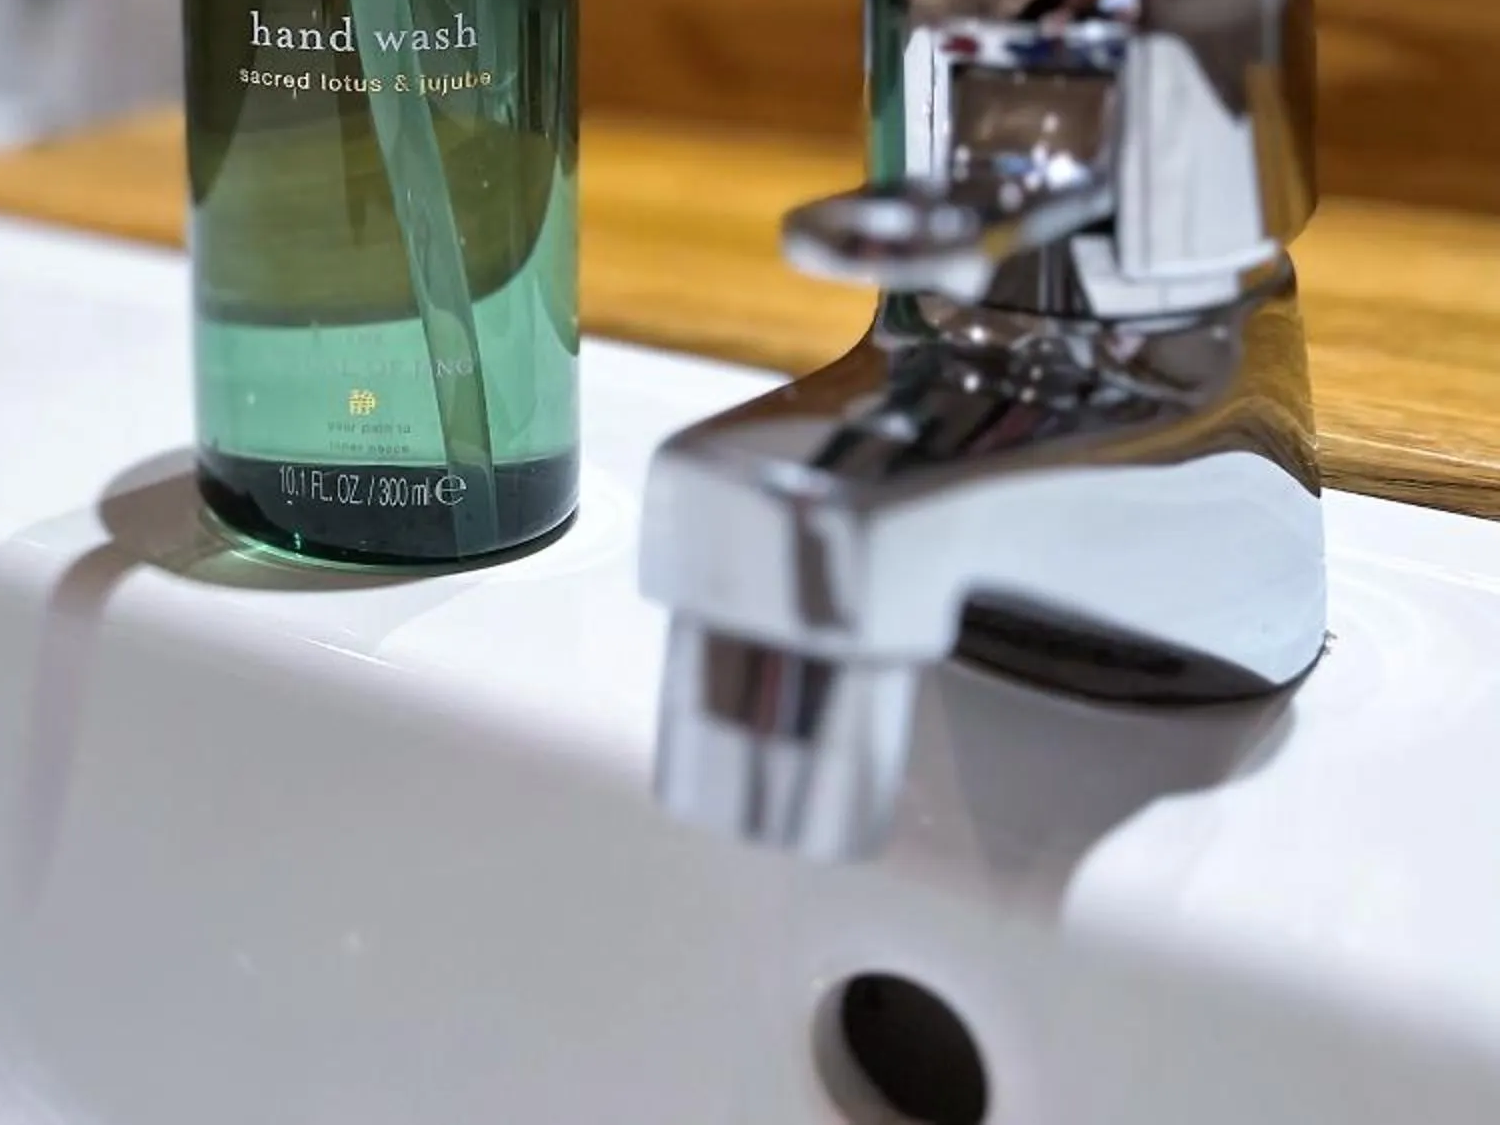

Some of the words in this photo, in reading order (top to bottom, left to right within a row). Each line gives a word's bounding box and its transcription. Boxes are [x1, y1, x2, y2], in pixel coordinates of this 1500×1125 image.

[249, 10, 355, 52] hand
[373, 12, 478, 52] wash
[238, 68, 311, 91] sacred
[320, 72, 383, 93] lotus
[394, 74, 410, 92] &
[418, 70, 492, 96] jujube
[278, 464, 306, 497] 10.1
[311, 470, 333, 502] FL.
[337, 474, 364, 505] OZ
[367, 475, 375, 506] /
[379, 477, 409, 507] 300
[411, 477, 430, 506] ml
